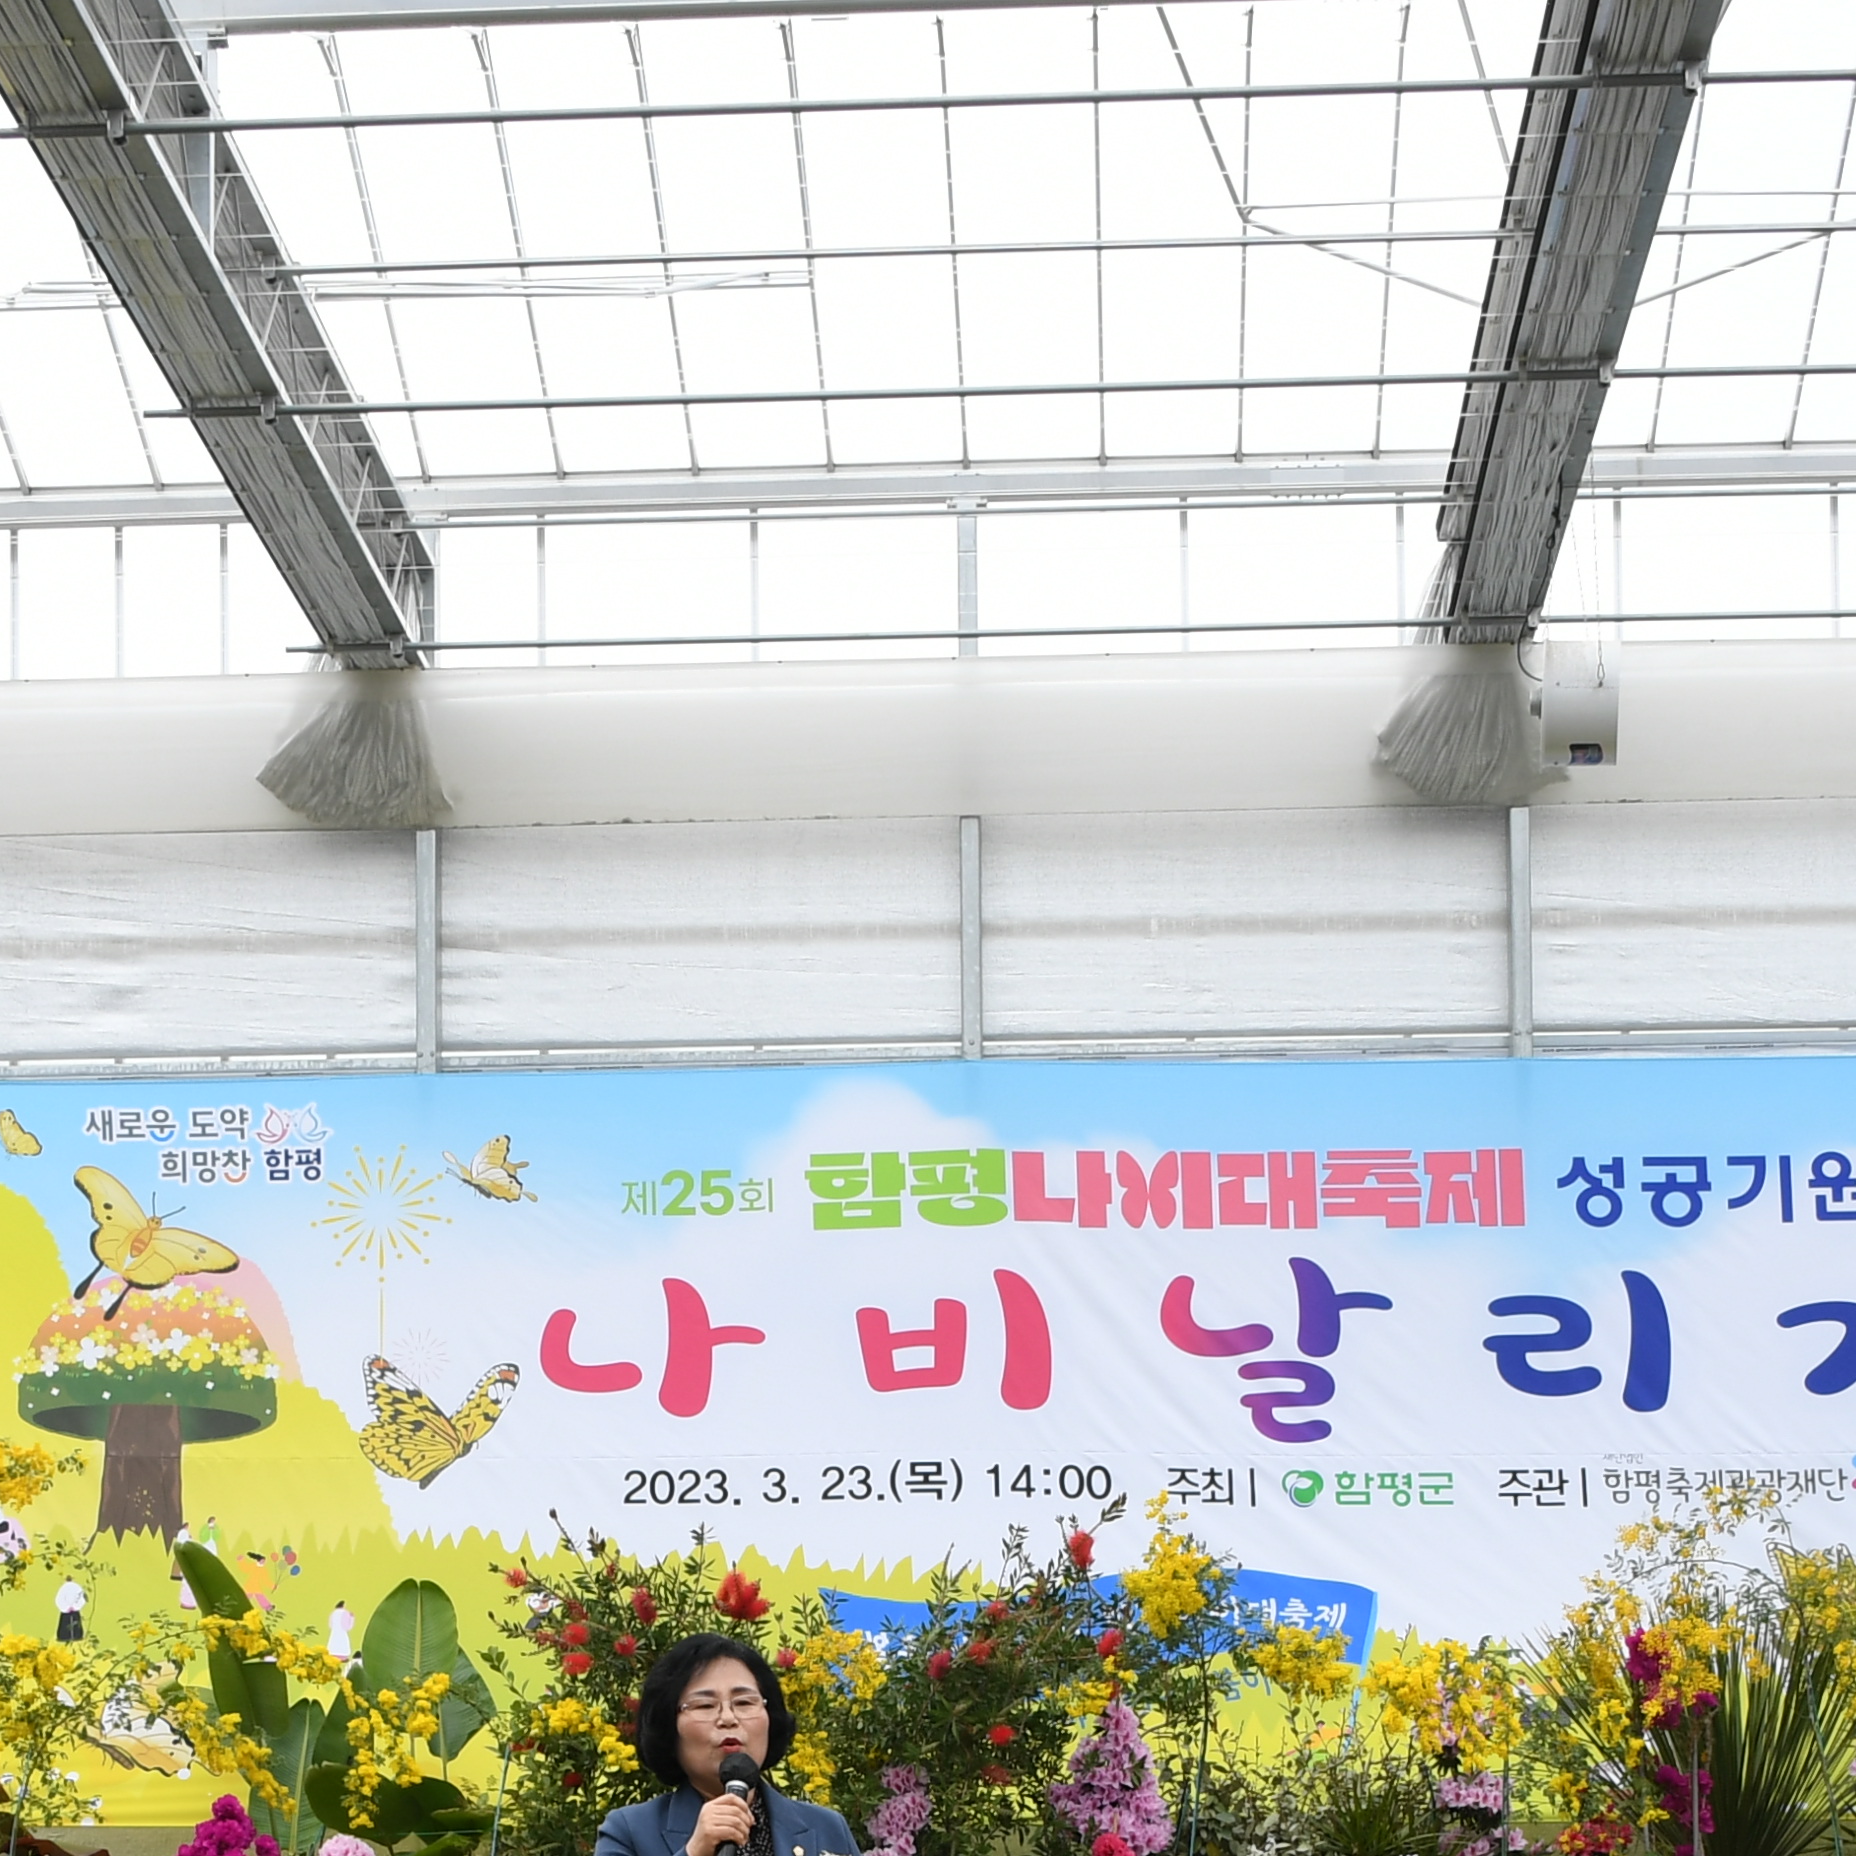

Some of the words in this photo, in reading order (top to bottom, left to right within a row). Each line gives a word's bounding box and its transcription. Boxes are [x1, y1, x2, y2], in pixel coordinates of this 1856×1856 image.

[85, 1108, 177, 1142] 새로운
[188, 1108, 249, 1140] 도약
[160, 1149, 251, 1183] 희망찬
[263, 1148, 322, 1181] 함평
[620, 1169, 775, 1217] 제25회
[624, 1469, 741, 1505] 2023.
[762, 1468, 800, 1503] 3.
[986, 1463, 1112, 1499] 14:00
[1334, 1471, 1454, 1506] 함평군
